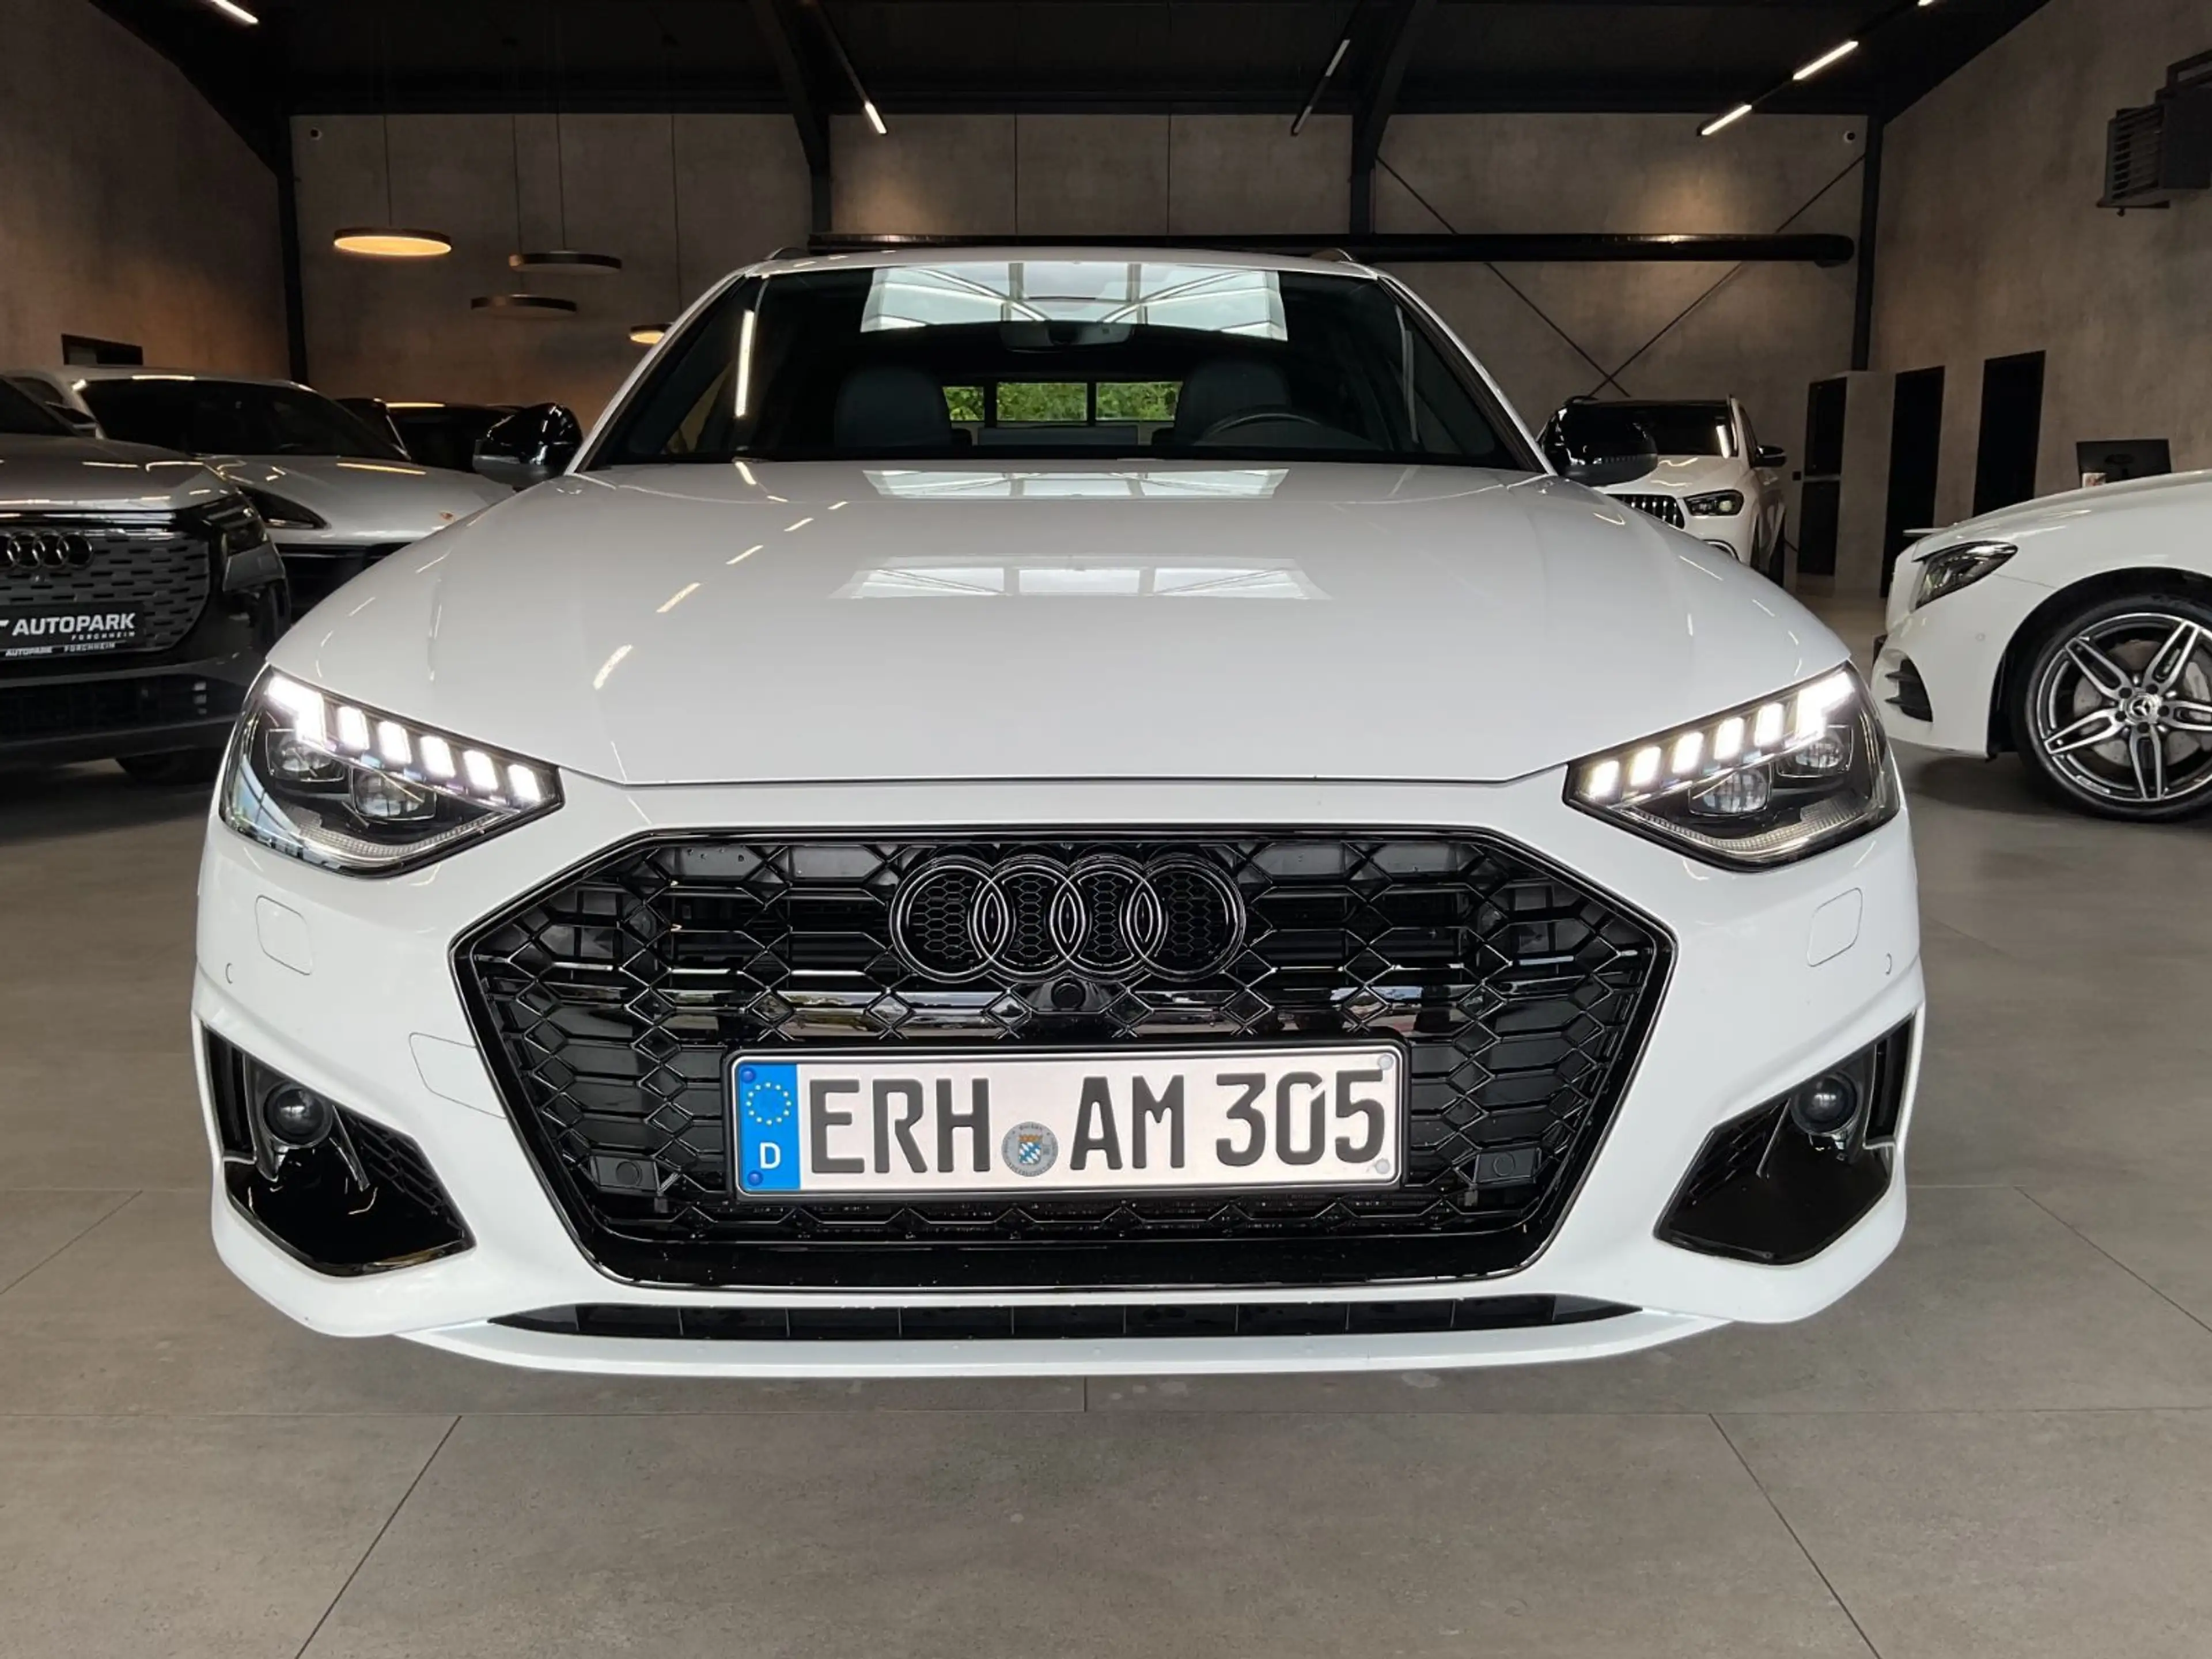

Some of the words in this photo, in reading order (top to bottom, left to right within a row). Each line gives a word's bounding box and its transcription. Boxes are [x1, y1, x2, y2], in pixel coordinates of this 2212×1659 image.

[12, 613, 135, 636] AUTOPARK
[810, 1078, 990, 1173] ERH
[1070, 1074, 1184, 1171] AM
[1217, 1069, 1385, 1166] 305
[760, 1142, 781, 1169] D
